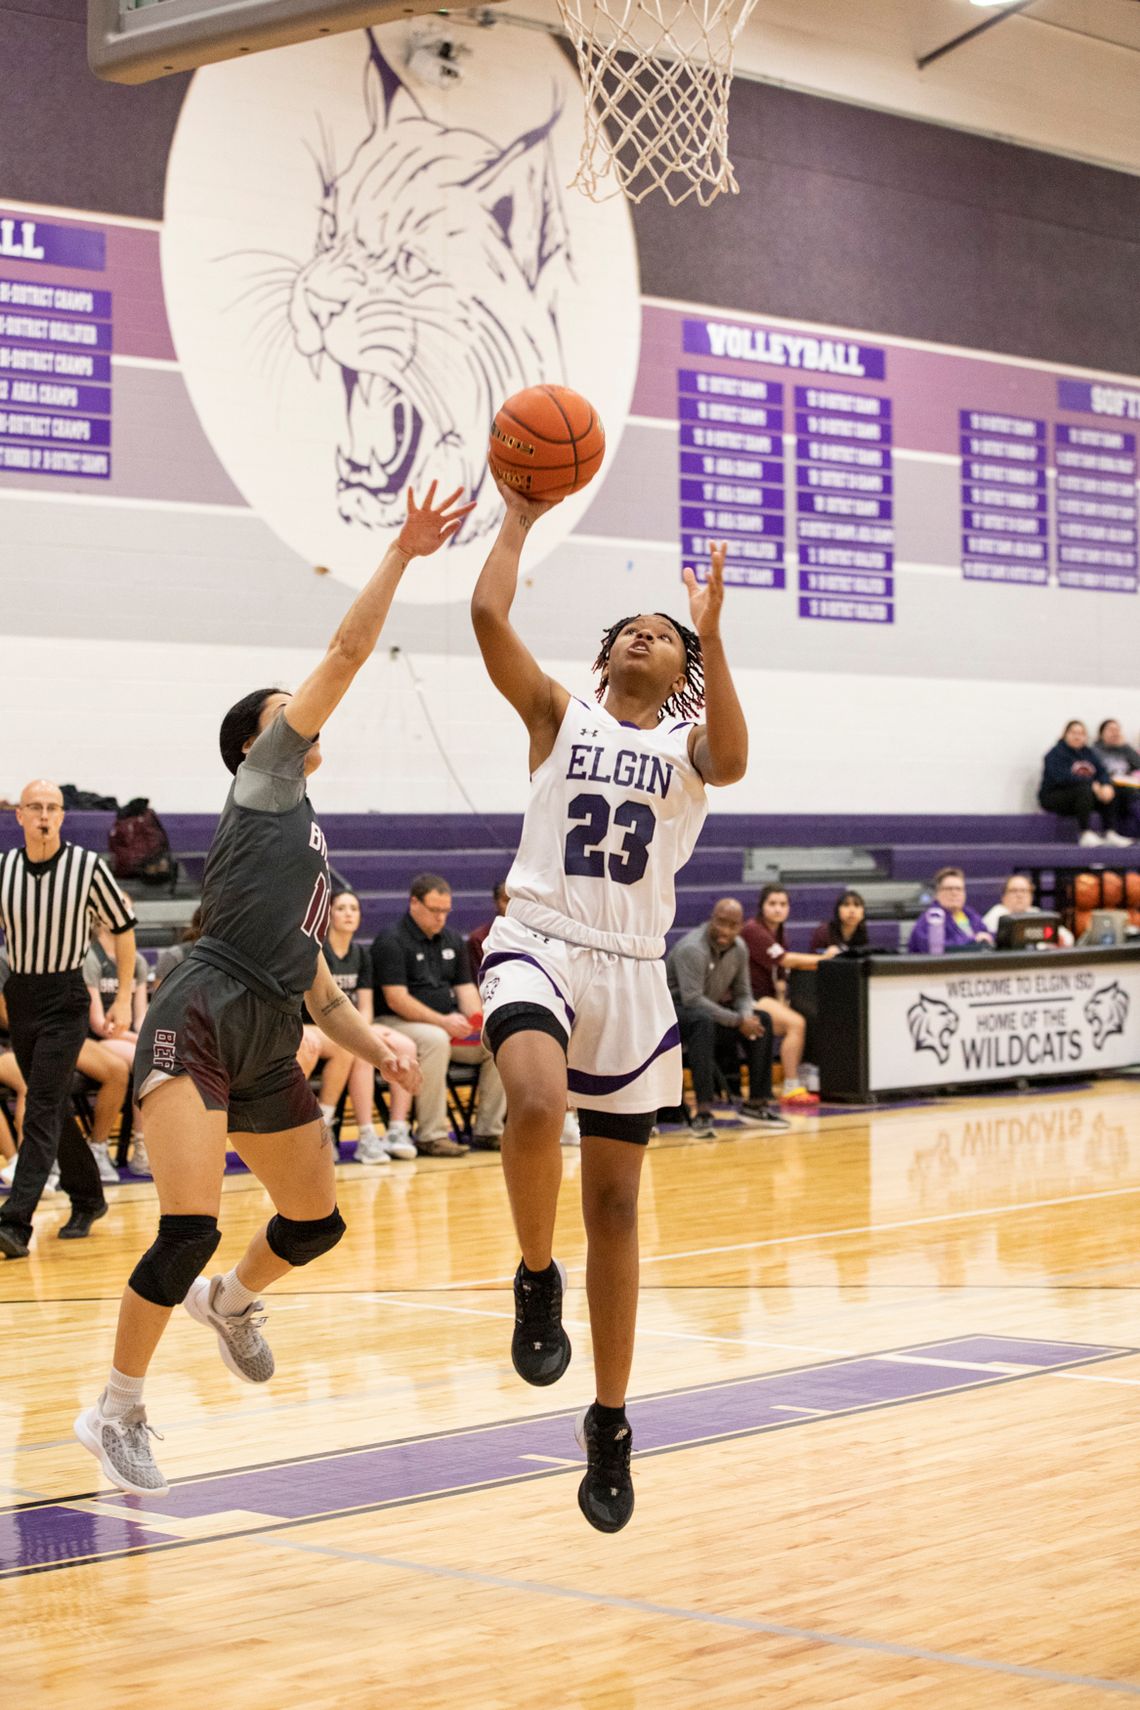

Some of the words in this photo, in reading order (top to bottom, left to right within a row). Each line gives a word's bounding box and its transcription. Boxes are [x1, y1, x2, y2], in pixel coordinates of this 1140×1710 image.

[0, 218, 44, 260] LL
[706, 322, 866, 378] VOLLEYBALL
[1091, 386, 1140, 420] SOFT
[566, 744, 673, 799] ELGIN
[565, 793, 656, 885] 23
[946, 977, 1012, 999] WELCOME
[1017, 976, 1032, 994] TO
[1036, 974, 1071, 993] ELGIN
[1074, 972, 1095, 990] ISD
[976, 1012, 1016, 1032] HOME
[1021, 1011, 1038, 1029] OF
[1042, 1008, 1067, 1027] THE
[961, 1029, 1083, 1070] WILDCATS
